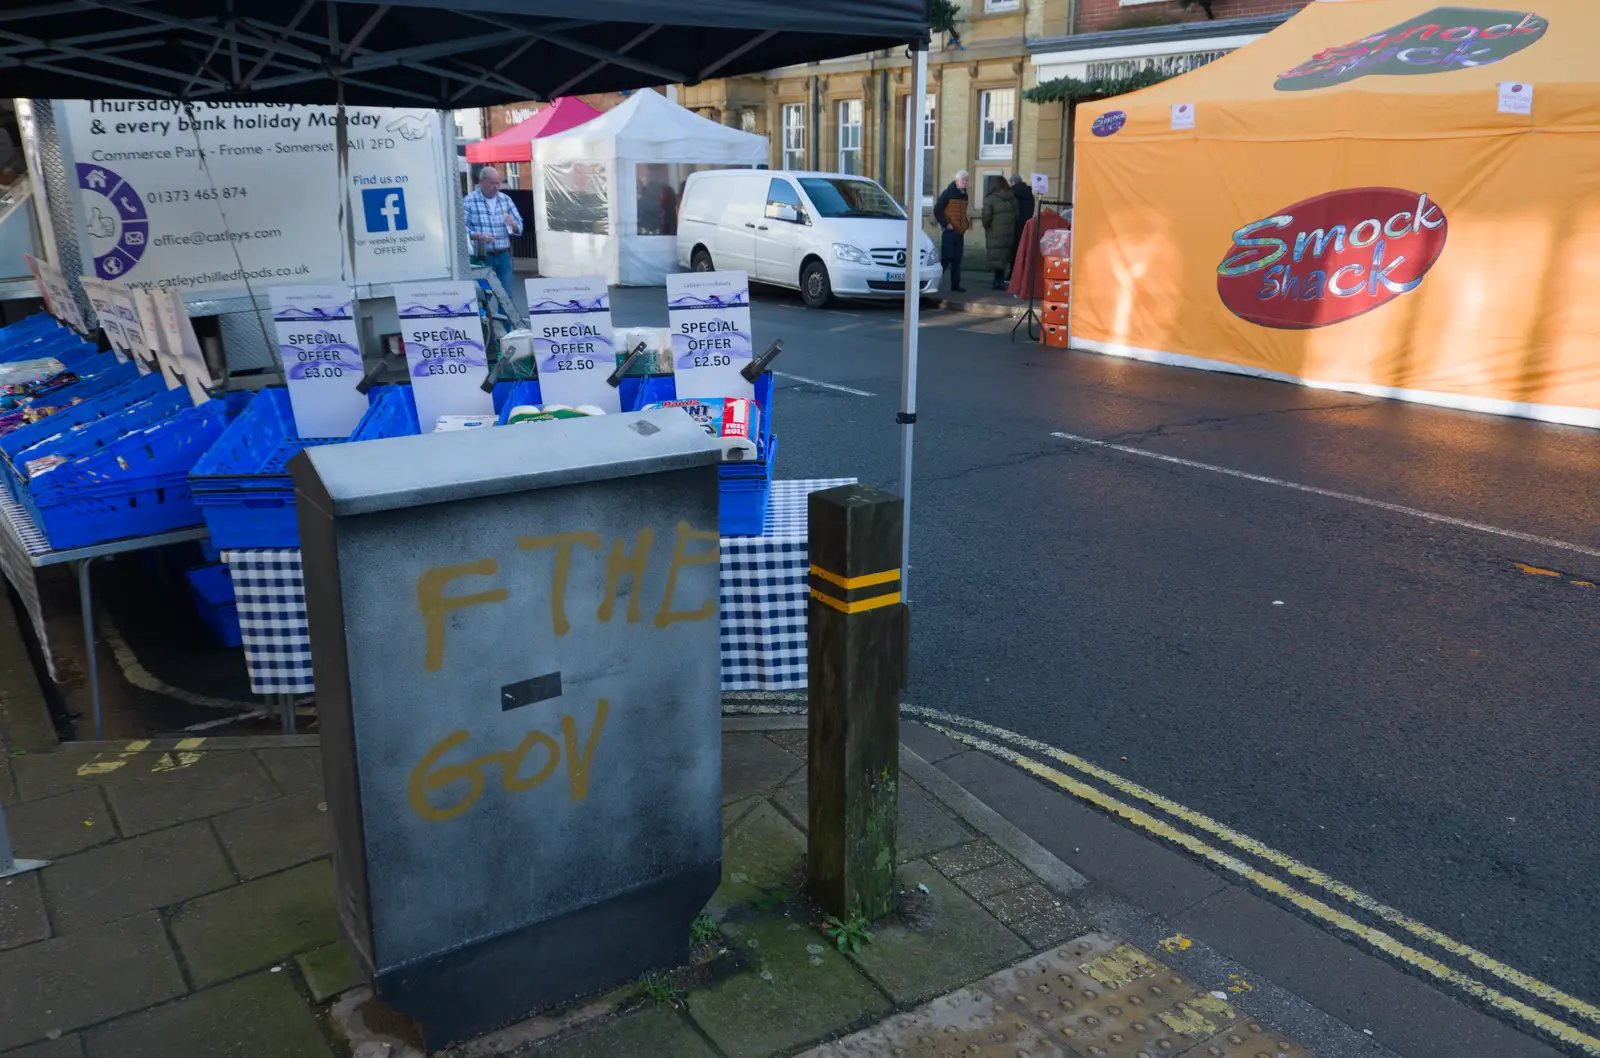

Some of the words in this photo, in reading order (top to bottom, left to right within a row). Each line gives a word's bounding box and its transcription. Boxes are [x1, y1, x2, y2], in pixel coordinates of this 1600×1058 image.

[90, 119, 107, 134] &
[115, 120, 170, 136] every
[178, 115, 226, 131] bank
[233, 112, 301, 132] holiday
[308, 111, 381, 129] Moday
[91, 149, 171, 162] Commerce
[176, 146, 206, 158] Park
[219, 144, 262, 156] Frome
[274, 140, 334, 154] Somerset
[370, 138, 396, 150] 2FD
[353, 174, 378, 185] Find
[380, 175, 392, 184] us
[394, 175, 409, 183] on
[147, 189, 190, 204] 01373
[194, 188, 219, 200] 465
[222, 186, 248, 199] 874
[153, 227, 282, 248] office@catleys.com
[368, 235, 397, 245] weekly
[399, 233, 426, 244] special
[1216, 192, 1444, 276] Smock
[373, 245, 408, 256] OFFERS
[124, 262, 310, 291] ww.catleychilledfoods.co.uk
[542, 325, 601, 338] SPECIAL
[681, 321, 739, 334] SPECIAL
[288, 333, 347, 345] SPECIAL
[413, 330, 471, 342] SPECIAL
[550, 342, 595, 354] OFFER
[688, 338, 732, 351] OFFER
[297, 349, 341, 362] OFFER
[422, 346, 466, 359] OFFER
[557, 359, 594, 370] £2.50
[694, 355, 731, 367] £2.50
[304, 366, 343, 378] £3.00
[428, 363, 467, 375] £3.00
[663, 400, 700, 408] Panda
[726, 399, 746, 423] 1
[417, 557, 510, 672] F
[517, 520, 720, 636] THE
[408, 697, 610, 822] GOV
